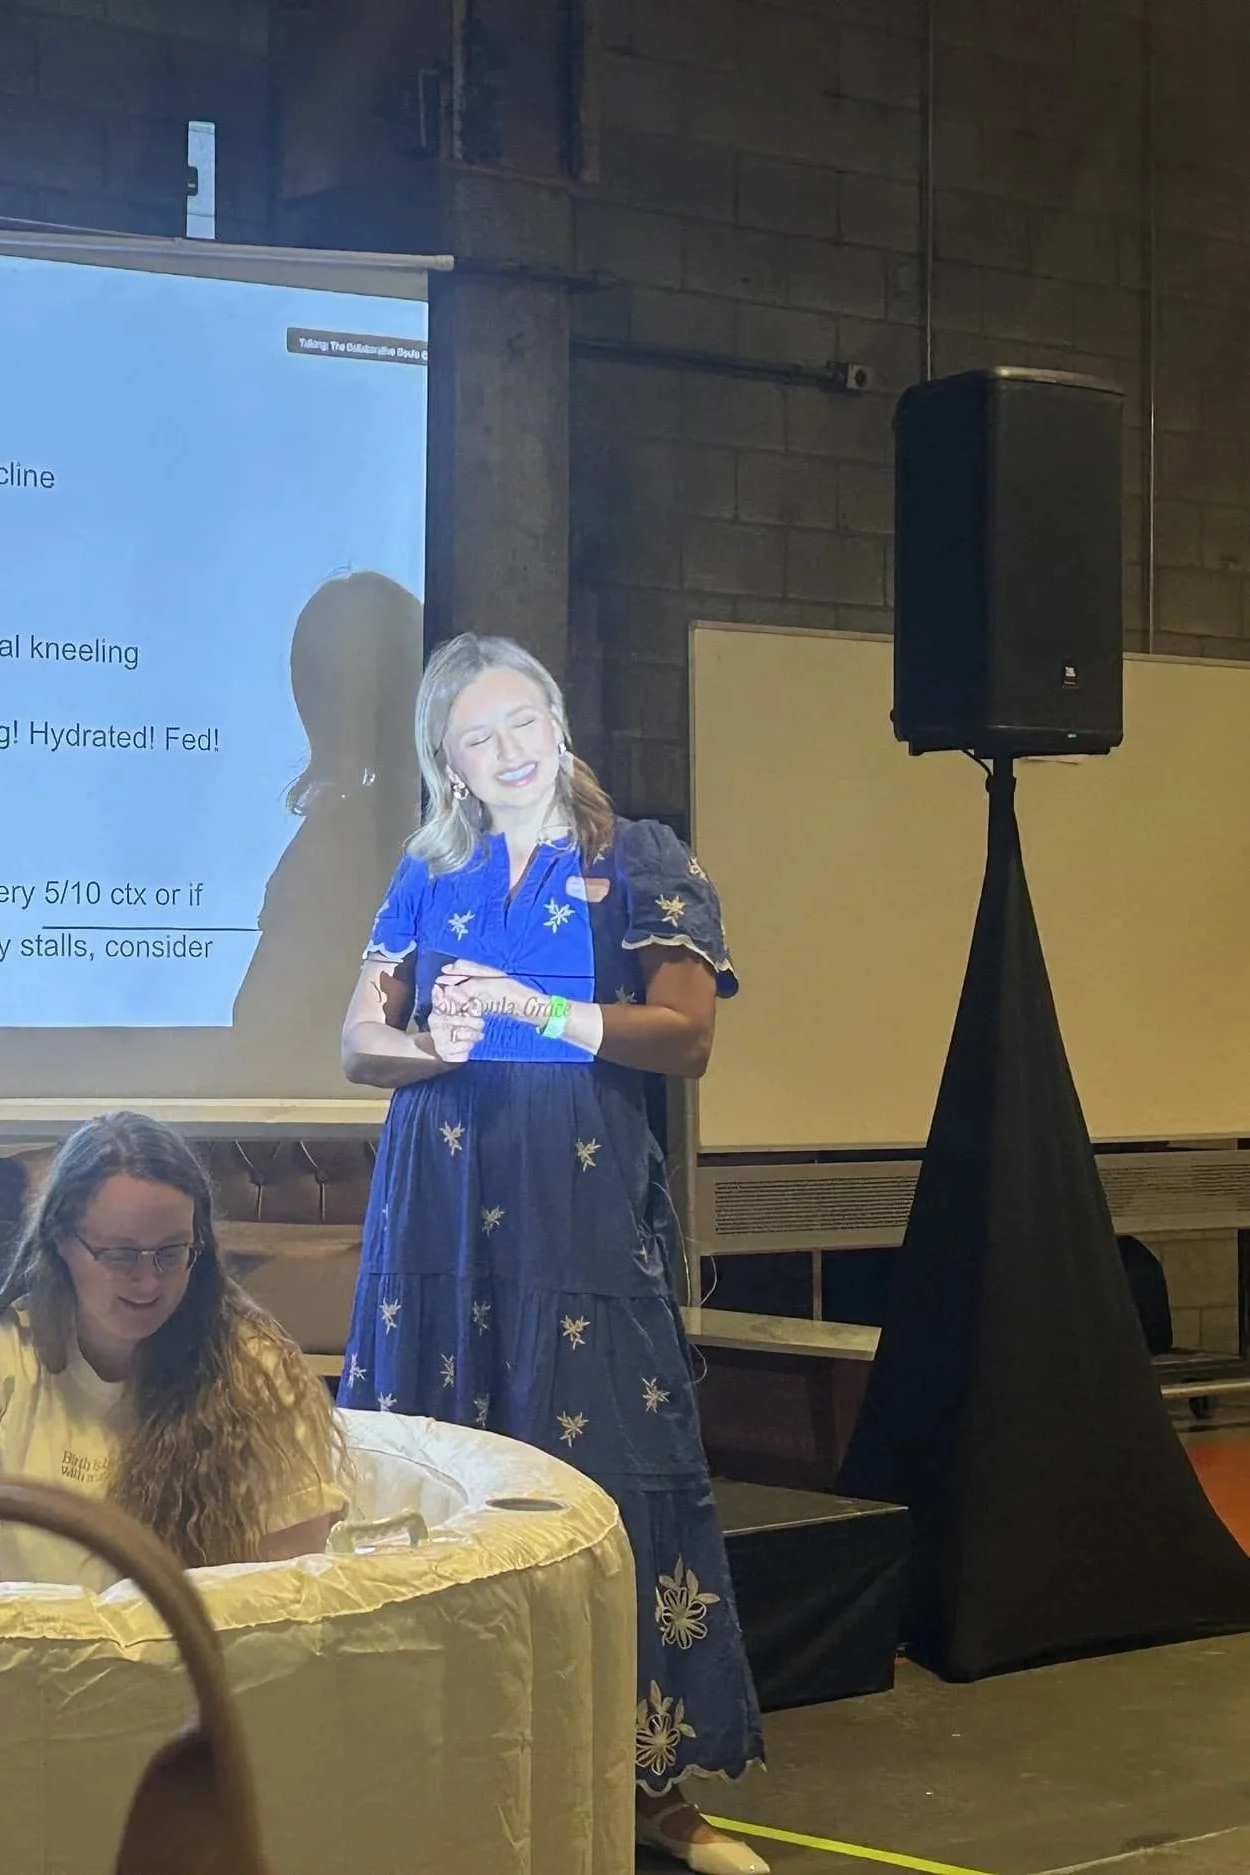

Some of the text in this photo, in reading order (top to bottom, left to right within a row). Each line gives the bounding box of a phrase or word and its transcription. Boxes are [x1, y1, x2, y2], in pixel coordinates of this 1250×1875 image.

[330, 340, 345, 352] The
[30, 634, 139, 671] kneeling
[30, 720, 155, 753] Hydrated!
[165, 726, 219, 753] Fed!
[44, 879, 101, 905] 5/10
[110, 882, 147, 906] ctx
[155, 887, 182, 906] or
[189, 882, 204, 907] if
[20, 932, 95, 962] stalls,
[105, 933, 214, 959] consider
